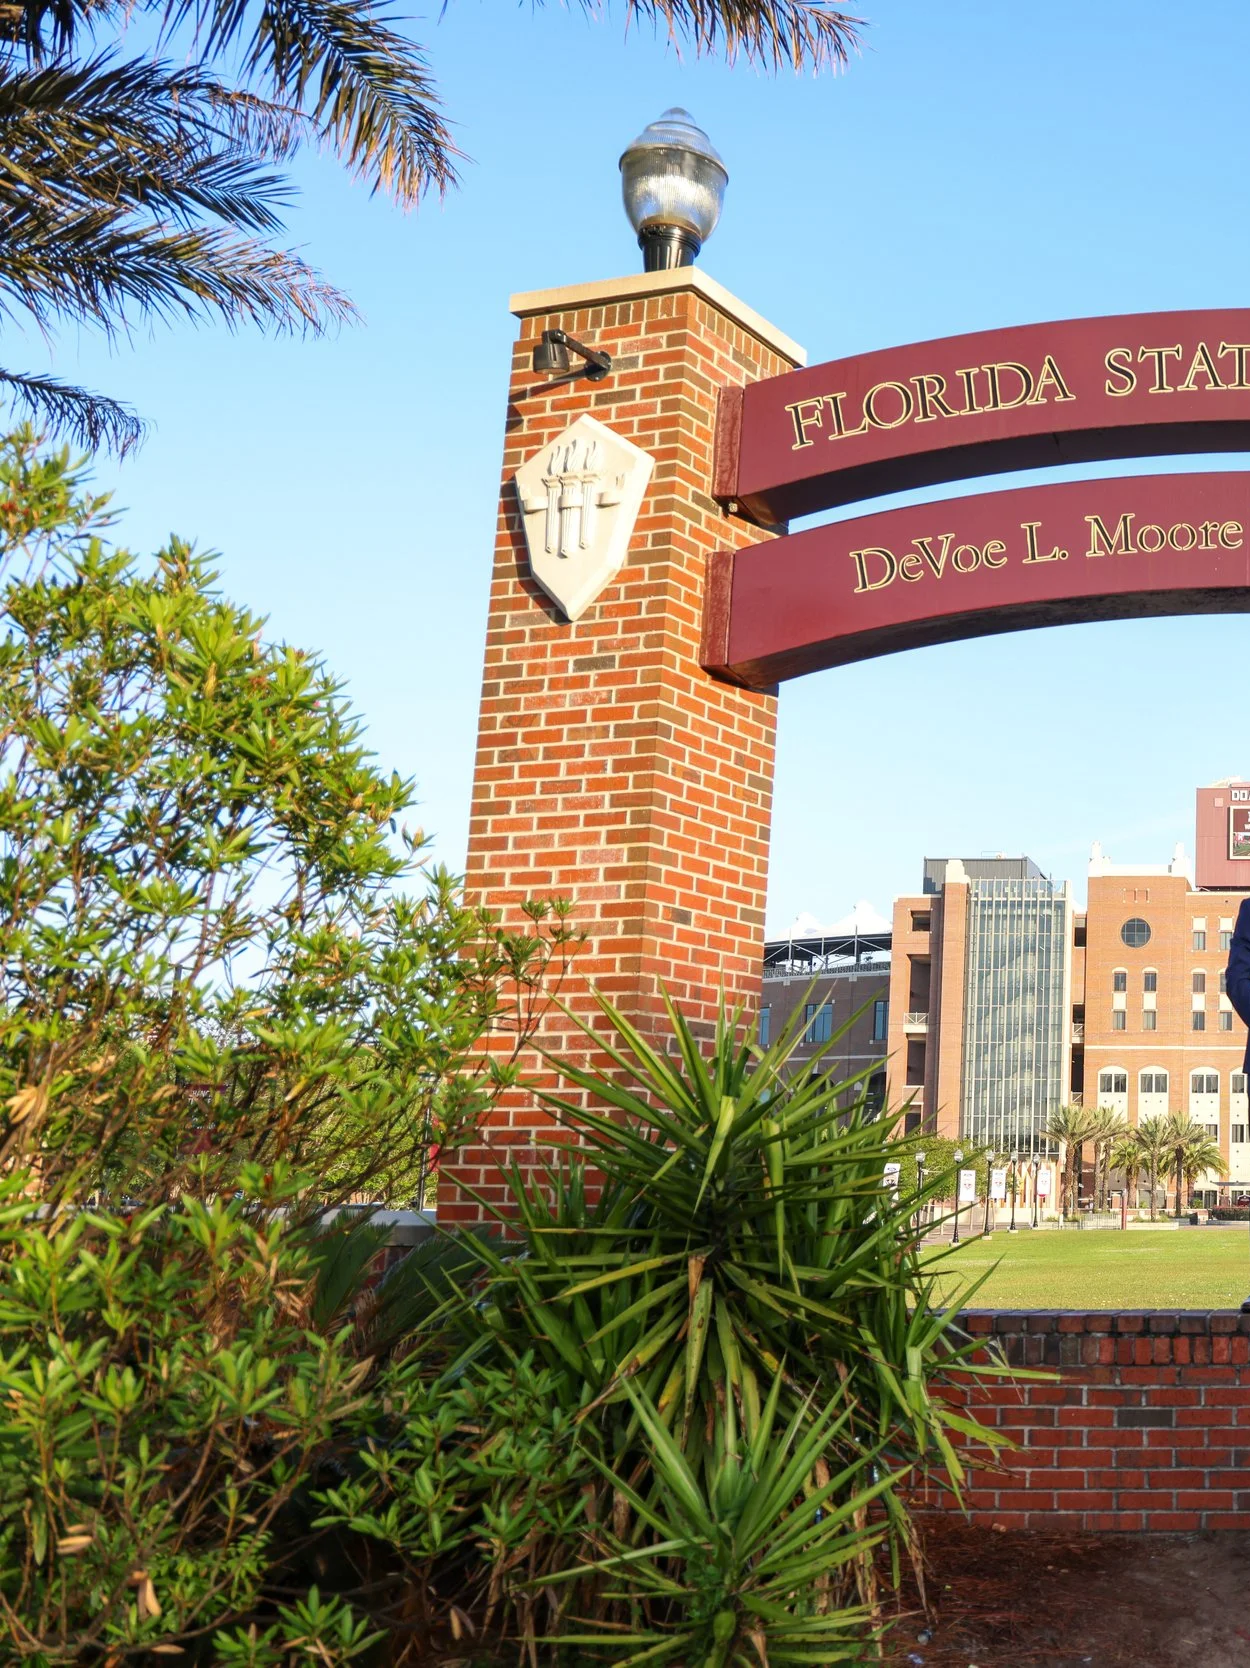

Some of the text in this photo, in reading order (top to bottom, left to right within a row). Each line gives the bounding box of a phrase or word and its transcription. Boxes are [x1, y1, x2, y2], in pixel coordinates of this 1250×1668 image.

[785, 355, 1076, 450] FLORIDA
[849, 533, 1007, 593] DeVoe
[1021, 521, 1068, 564] L.
[1085, 513, 1244, 557] Moore
